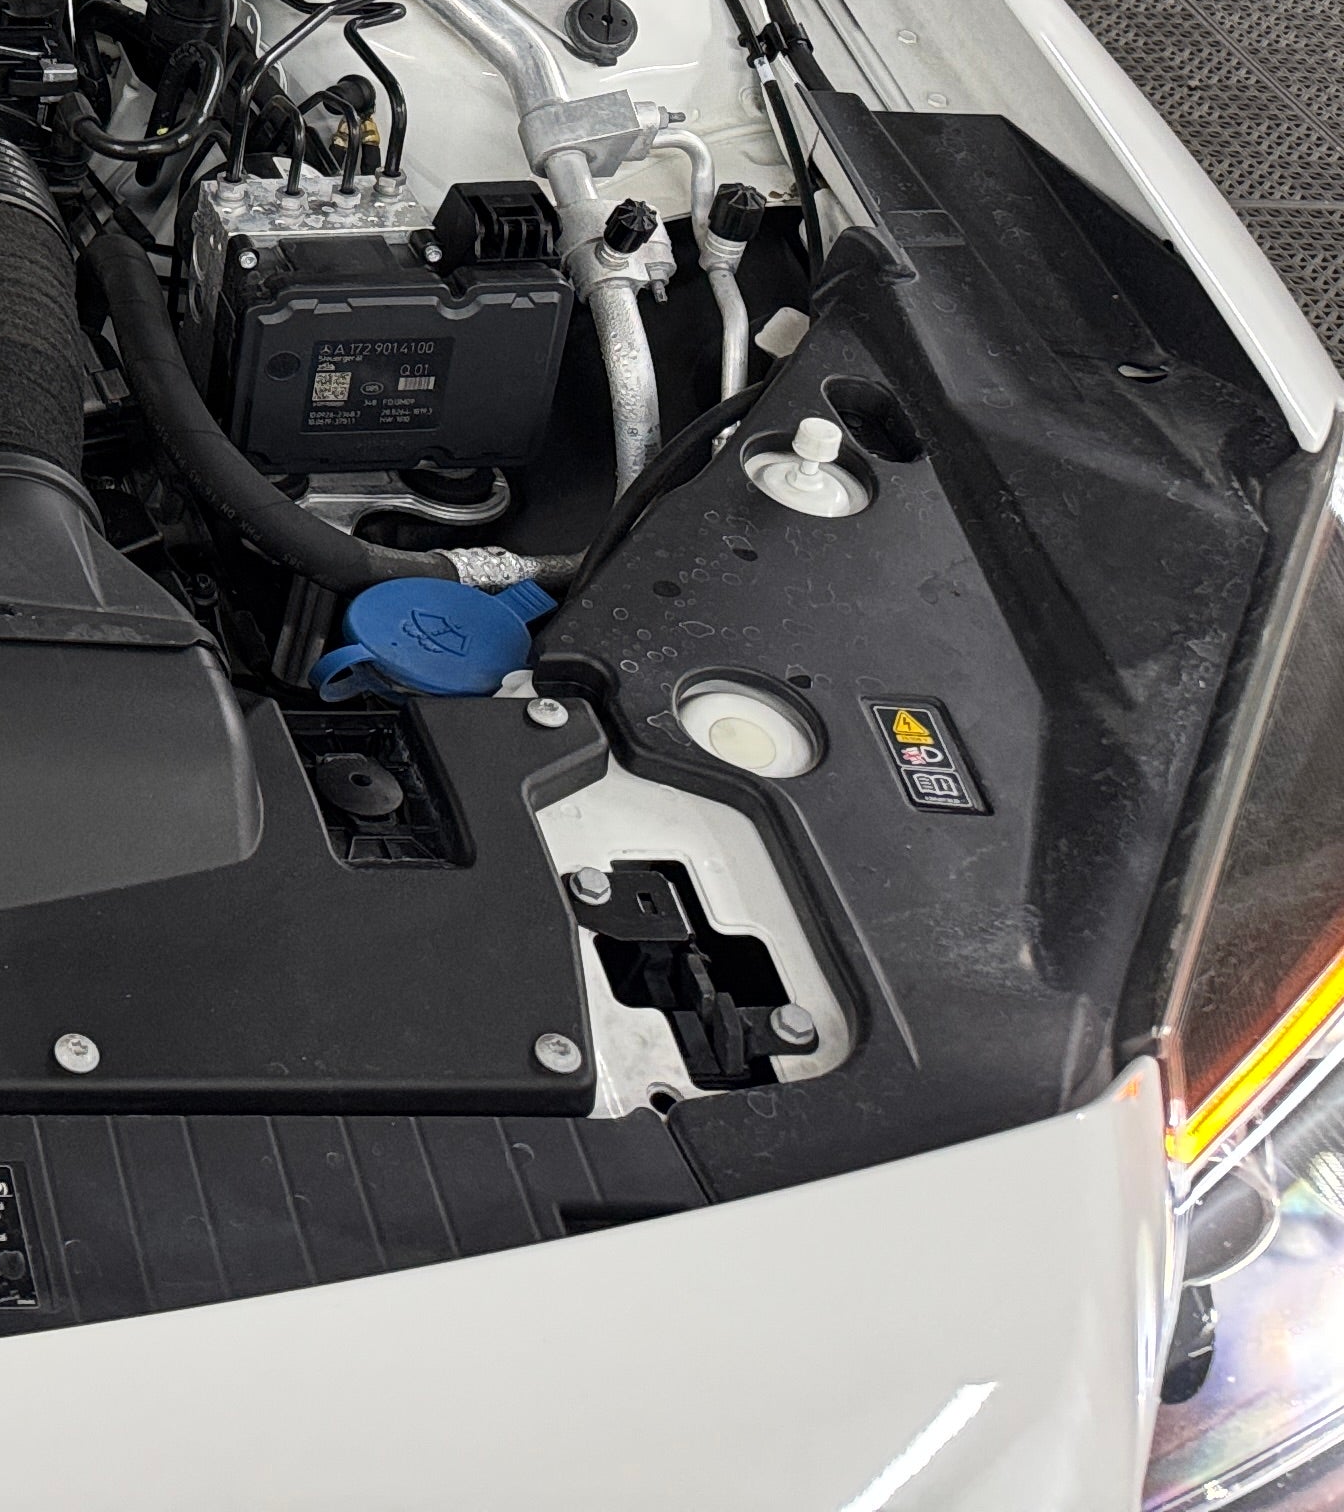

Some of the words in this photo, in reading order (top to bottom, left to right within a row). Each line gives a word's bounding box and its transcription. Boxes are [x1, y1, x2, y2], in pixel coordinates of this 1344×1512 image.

[334, 343, 346, 356] A
[349, 342, 373, 356] 172
[375, 341, 435, 355] 9014100
[400, 364, 411, 377] Q
[414, 363, 429, 376] 01
